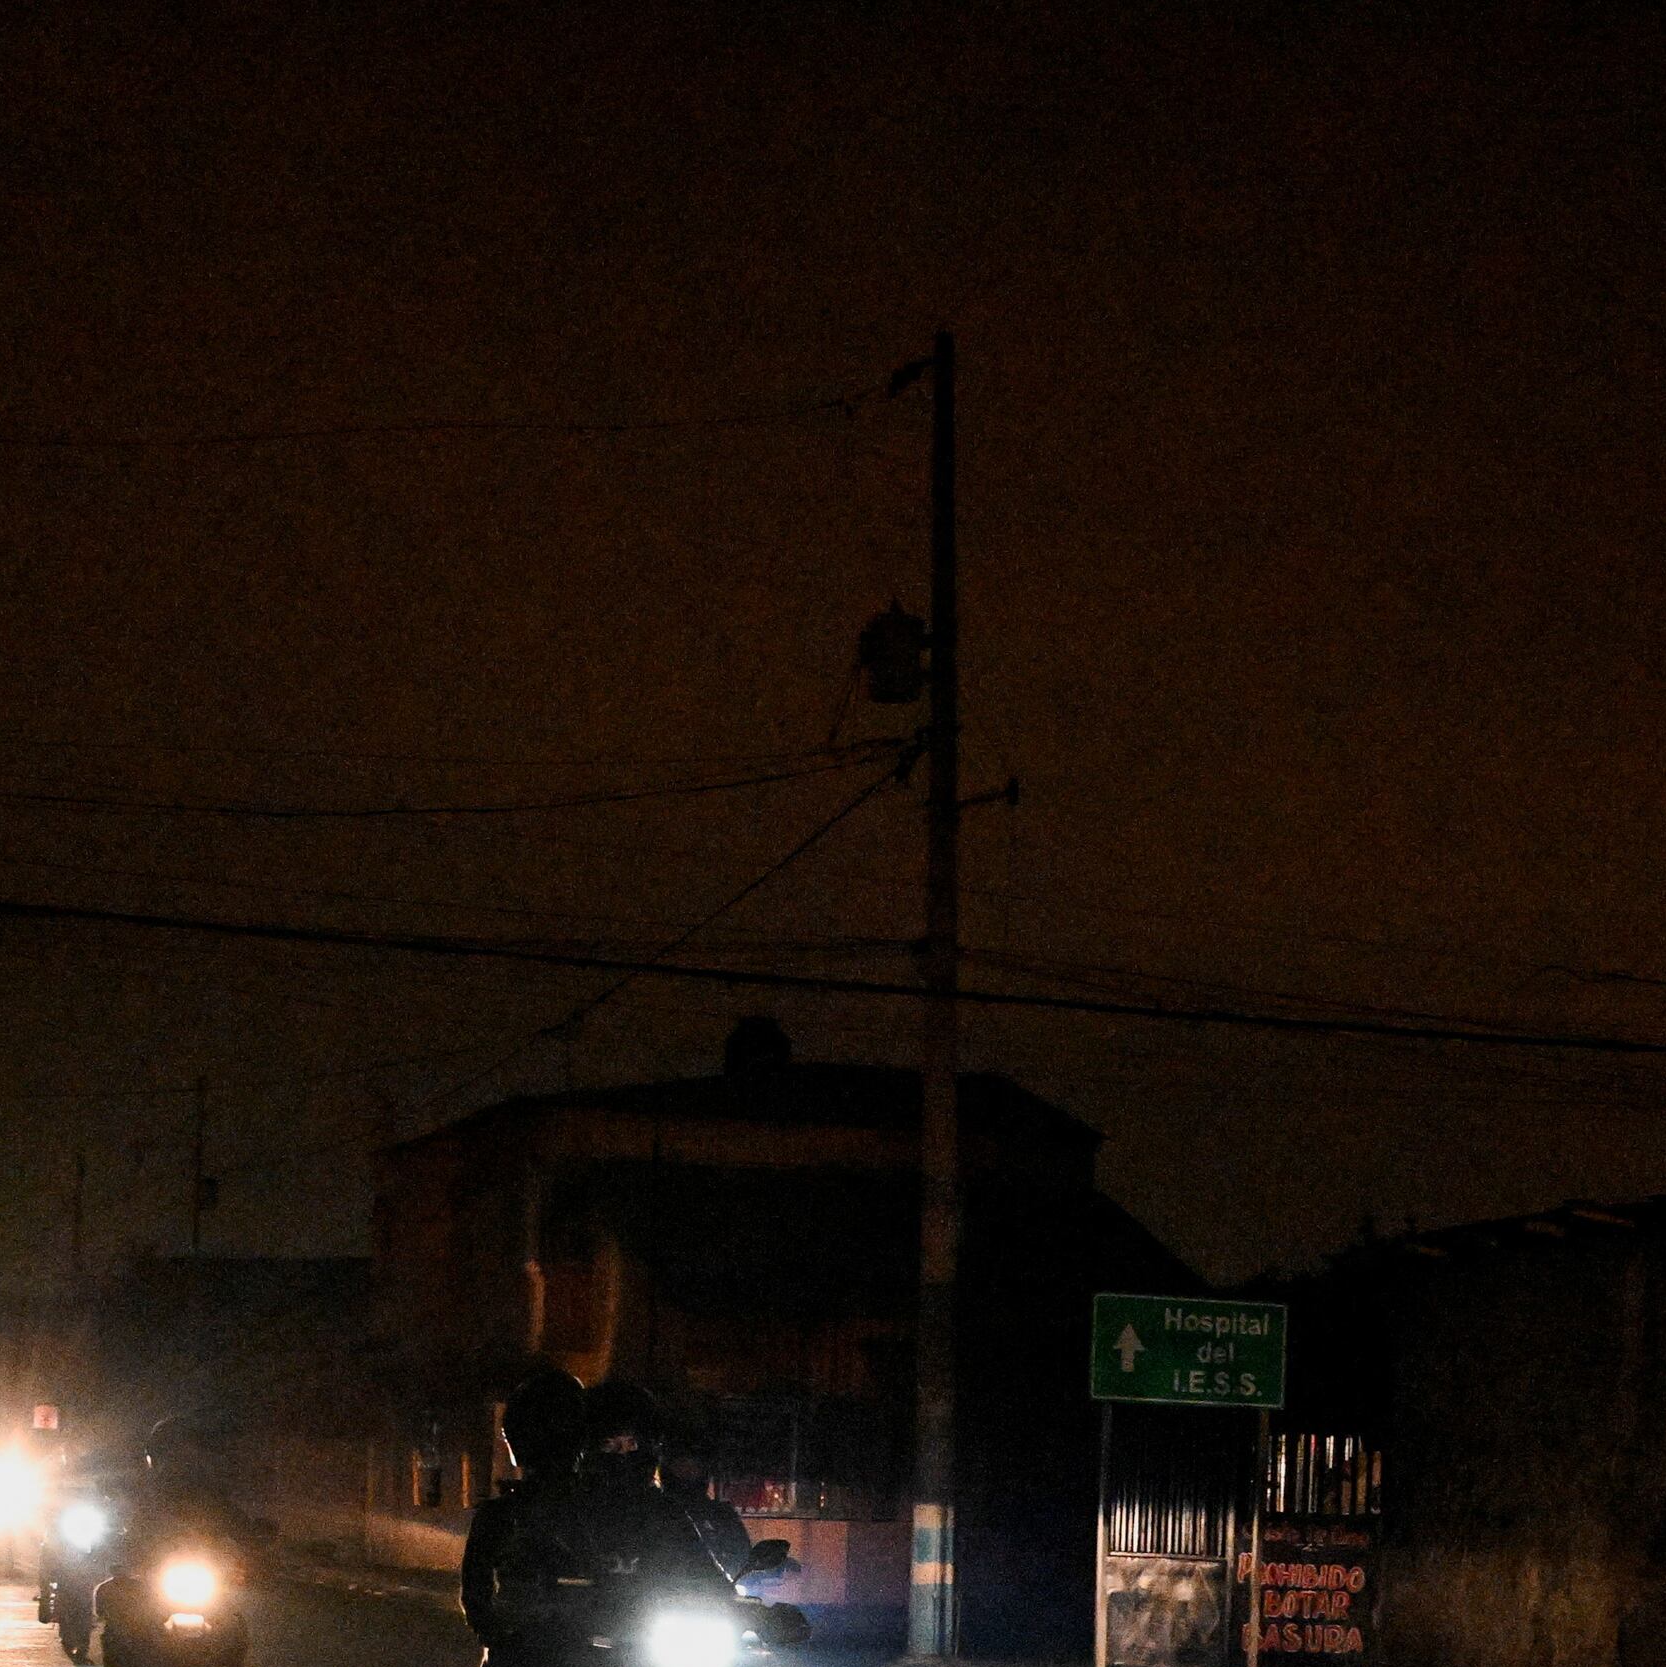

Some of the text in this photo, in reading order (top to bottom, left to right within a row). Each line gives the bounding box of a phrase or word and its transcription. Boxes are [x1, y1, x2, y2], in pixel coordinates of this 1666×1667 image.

[1164, 1307, 1271, 1339] Hospital
[1196, 1341, 1235, 1364] del
[1264, 1588, 1351, 1620] BOTAR
